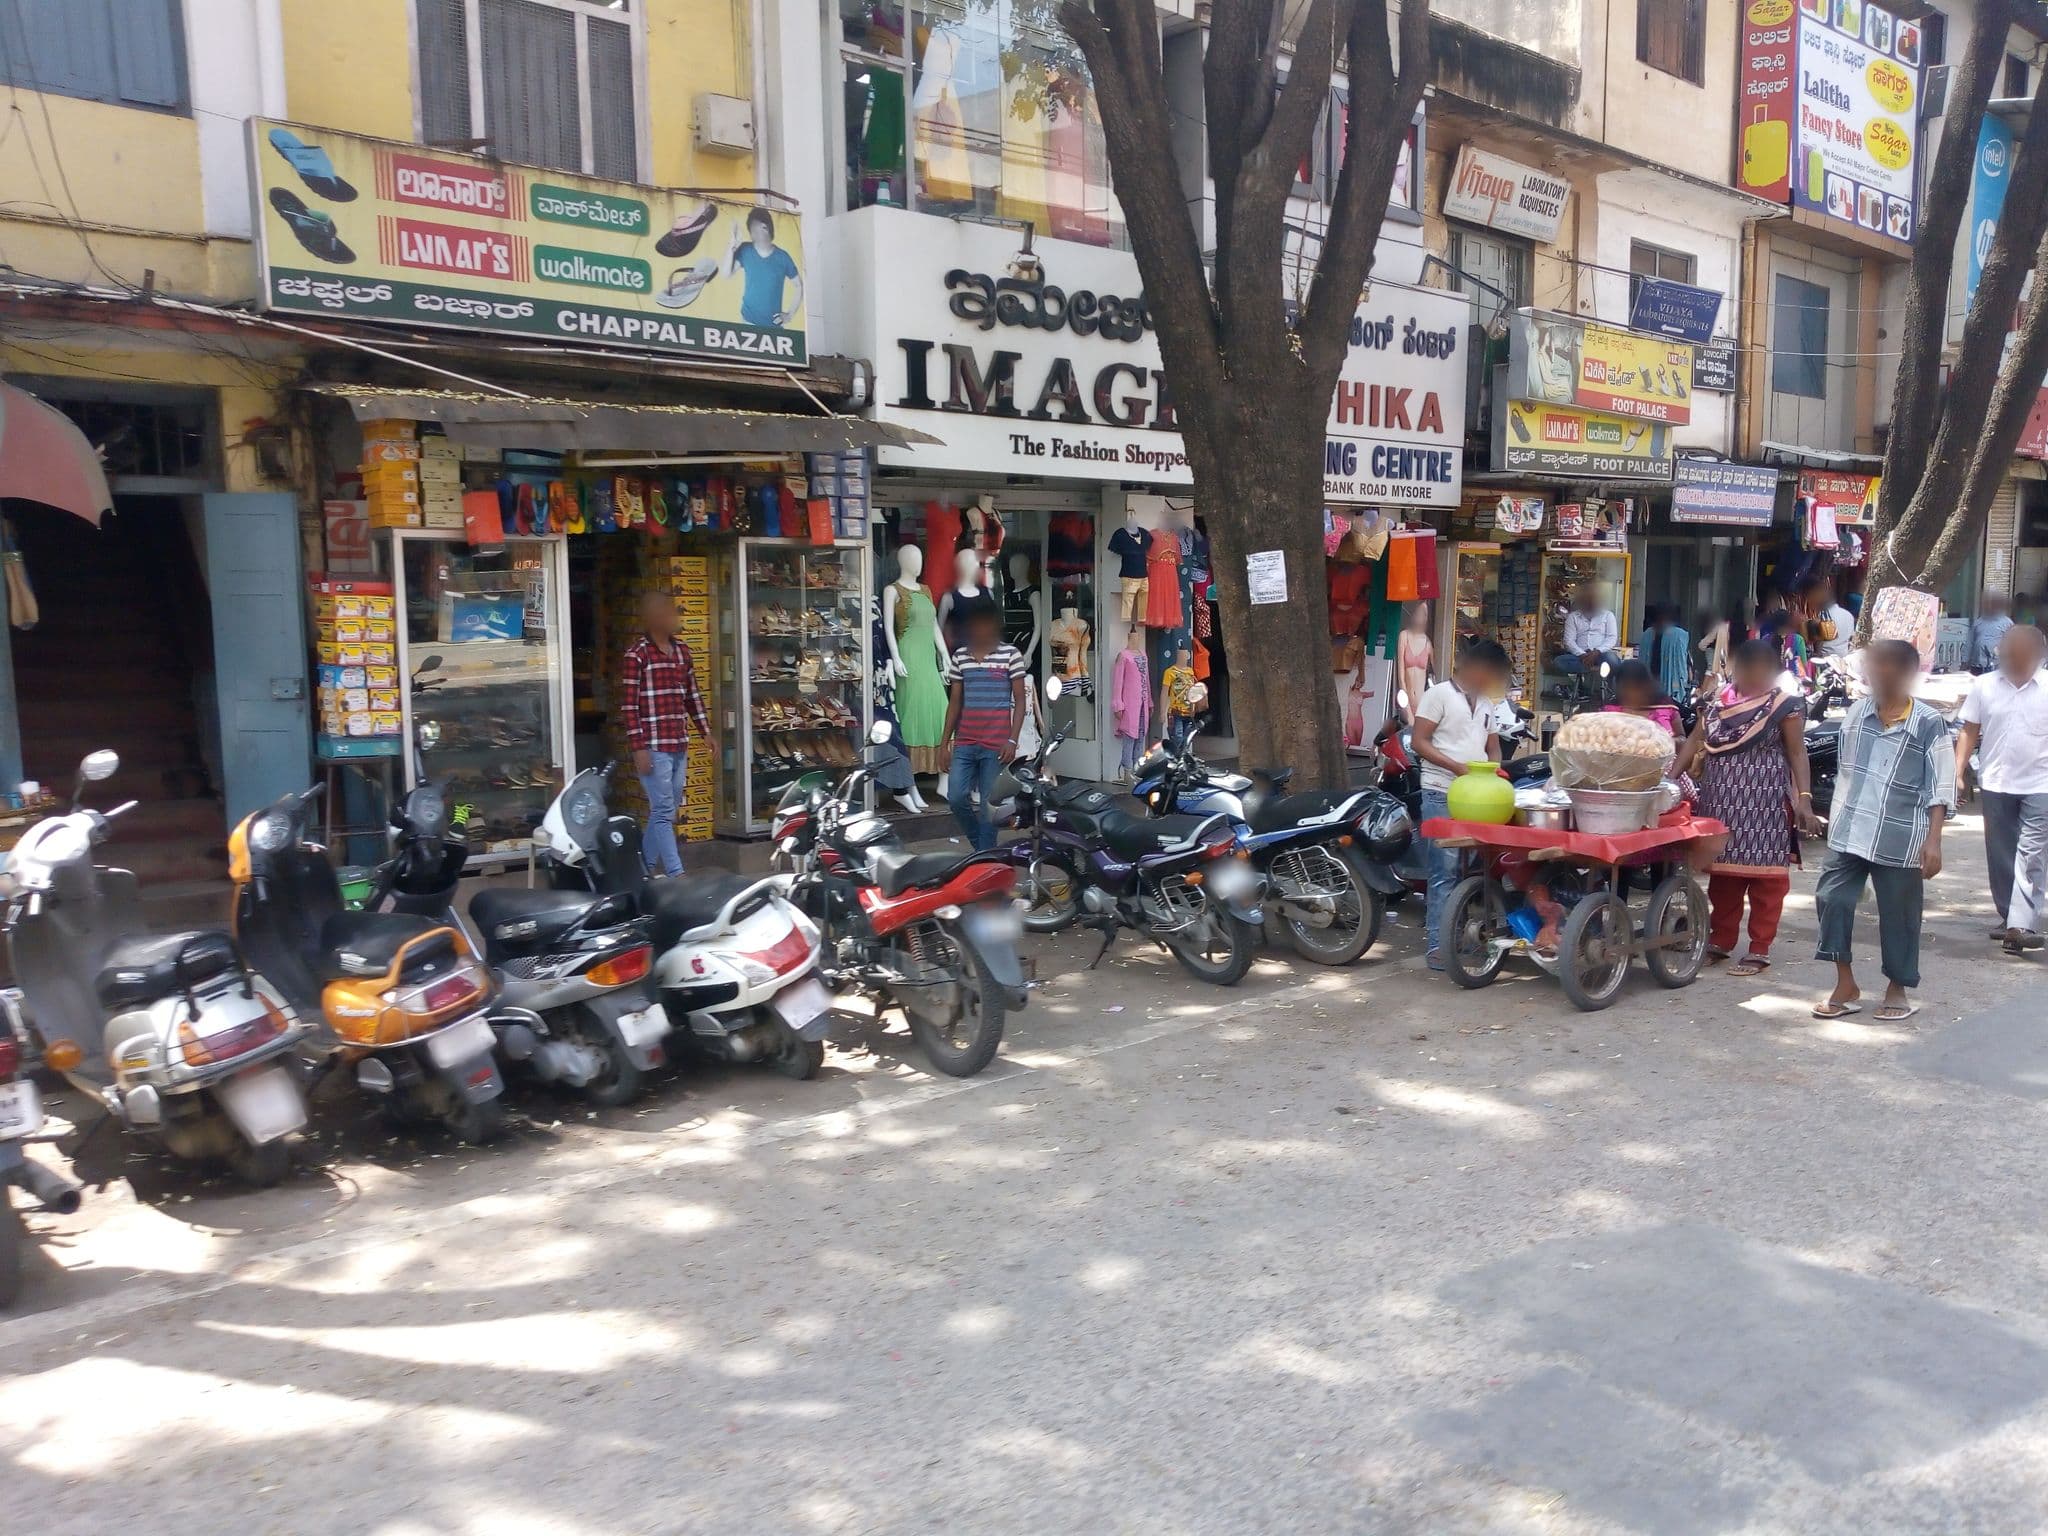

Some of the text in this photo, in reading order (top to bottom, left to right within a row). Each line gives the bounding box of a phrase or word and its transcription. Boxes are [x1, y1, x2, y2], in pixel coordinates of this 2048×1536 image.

[1749, 26, 1791, 46] ಲಲಿತ
[1804, 70, 1850, 112] Lalitha
[1802, 104, 1862, 150] Fancy Store
[1870, 122, 1908, 151] Sagar
[1456, 153, 1516, 225] Vijaya
[1522, 174, 1567, 201] LABORATORY
[1519, 193, 1560, 219] REQUISITES
[540, 256, 645, 288] walkmate
[277, 276, 393, 308] ಚಪ್ಪಲ್
[557, 310, 795, 357] CHAPPAL BAZAR
[1703, 350, 1729, 360] ADVOCATE
[1612, 398, 1667, 418] FOOT PALACE
[1010, 434, 1045, 456] The
[1052, 438, 1120, 463] Fashion
[1588, 426, 1620, 442] walkmate
[1372, 445, 1453, 483] CENTRE
[1593, 458, 1669, 474] FOOT PALACE
[1360, 483, 1387, 497] ROAD
[1392, 485, 1432, 499] MYSORE
